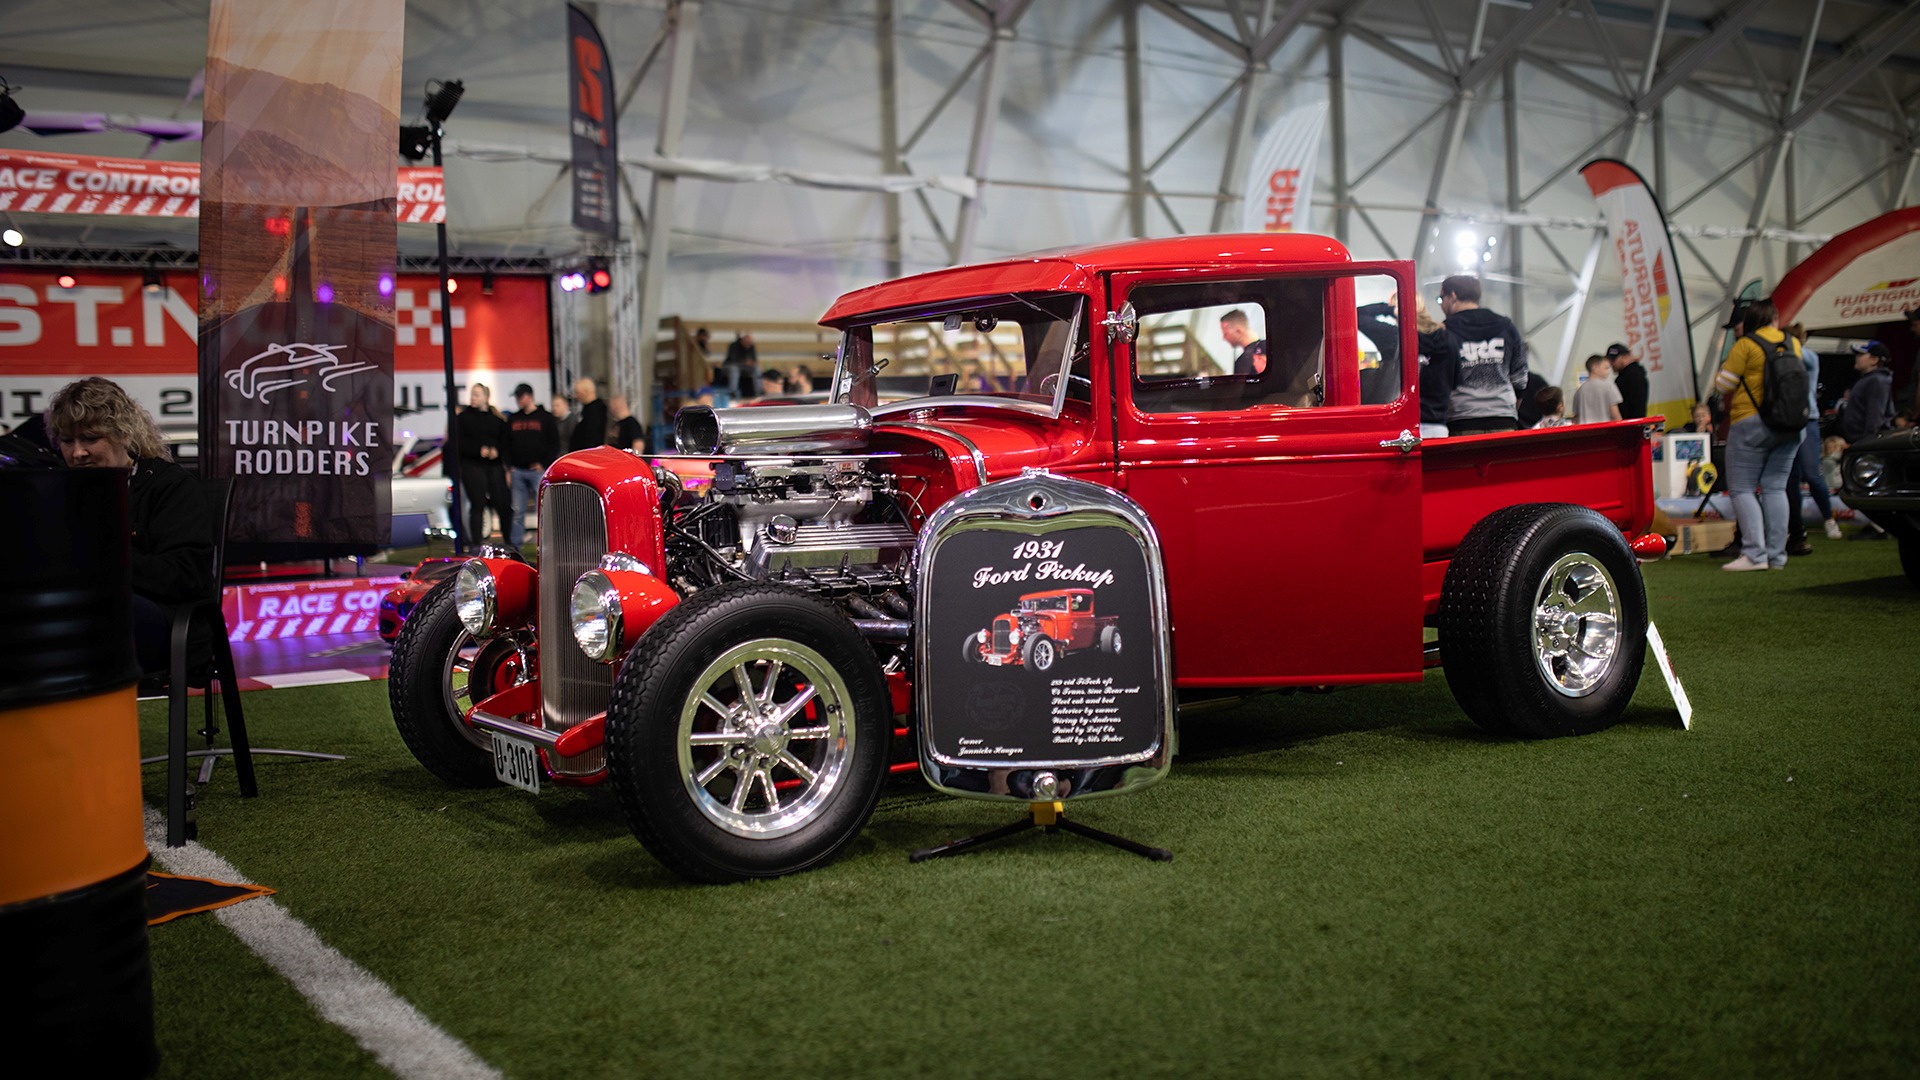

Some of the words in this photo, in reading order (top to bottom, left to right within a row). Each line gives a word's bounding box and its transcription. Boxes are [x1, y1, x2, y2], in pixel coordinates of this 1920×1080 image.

[66, 171, 199, 196] CONTROL
[225, 420, 379, 447] TURNPIKE
[235, 449, 370, 477] RODDERS
[1012, 540, 1065, 560] 1931
[972, 562, 1032, 589] Ford
[1035, 560, 1115, 589] Pickup
[257, 593, 339, 619] RACE
[1124, 686, 1141, 694] end
[1085, 696, 1102, 705] and
[1101, 696, 1116, 704] bed
[1084, 707, 1094, 717] by
[1079, 716, 1089, 726] by
[1052, 726, 1075, 734] Paint
[1075, 726, 1085, 736] by
[959, 737, 984, 745] Owner
[1074, 736, 1084, 746] by
[493, 737, 537, 788] U-3101
